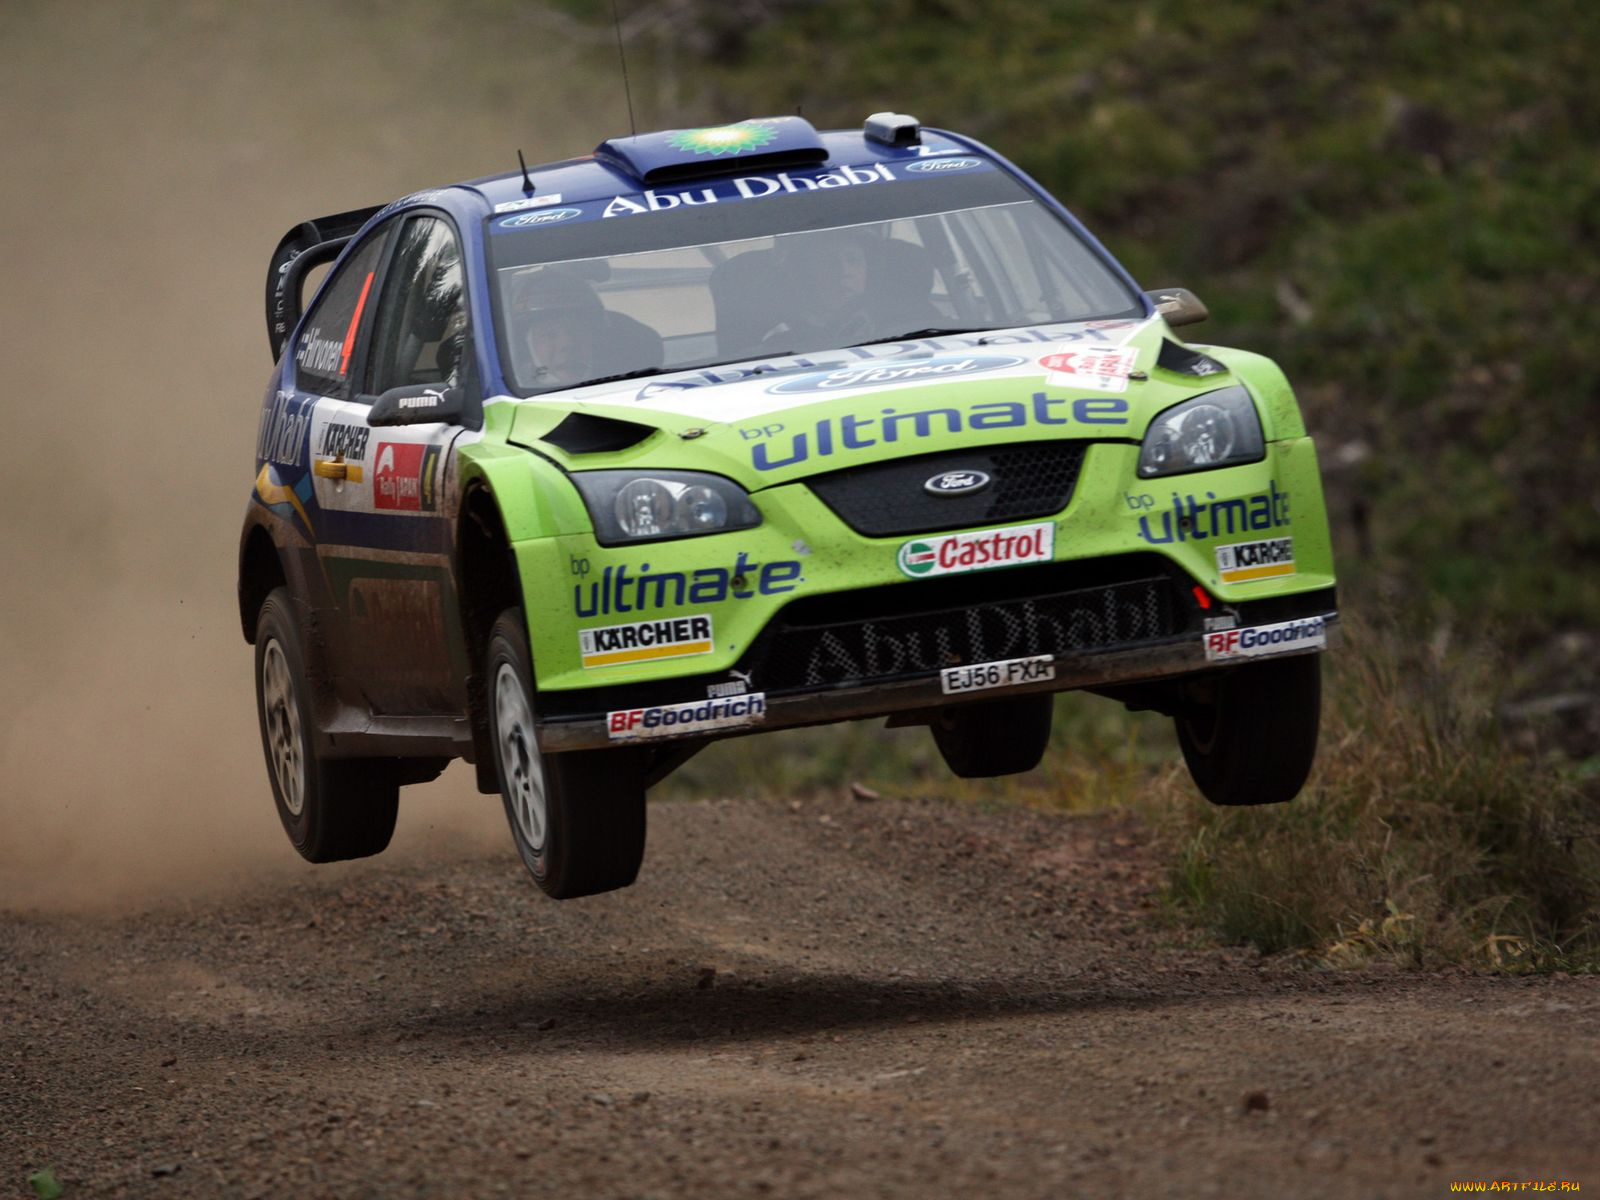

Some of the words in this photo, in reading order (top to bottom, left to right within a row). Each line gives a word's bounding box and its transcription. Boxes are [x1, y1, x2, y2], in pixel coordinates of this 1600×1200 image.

[602, 188, 718, 218] Abu
[734, 162, 897, 199] Dhabi
[816, 357, 977, 388] Ford
[398, 396, 438, 409] PUMA
[738, 422, 785, 441] bp
[751, 392, 1129, 471] ultimate
[1124, 490, 1155, 511] bp
[939, 528, 1045, 569] Castrol
[1233, 539, 1292, 567] KÄRCHE
[570, 553, 591, 578] bp
[575, 552, 801, 618] ultimate
[593, 616, 710, 652] KÄRCHER
[1208, 620, 1325, 653] BFGoodrich
[947, 666, 1000, 690] EJ56
[1007, 660, 1050, 682] FXA
[609, 695, 764, 733] BFGoodrich
